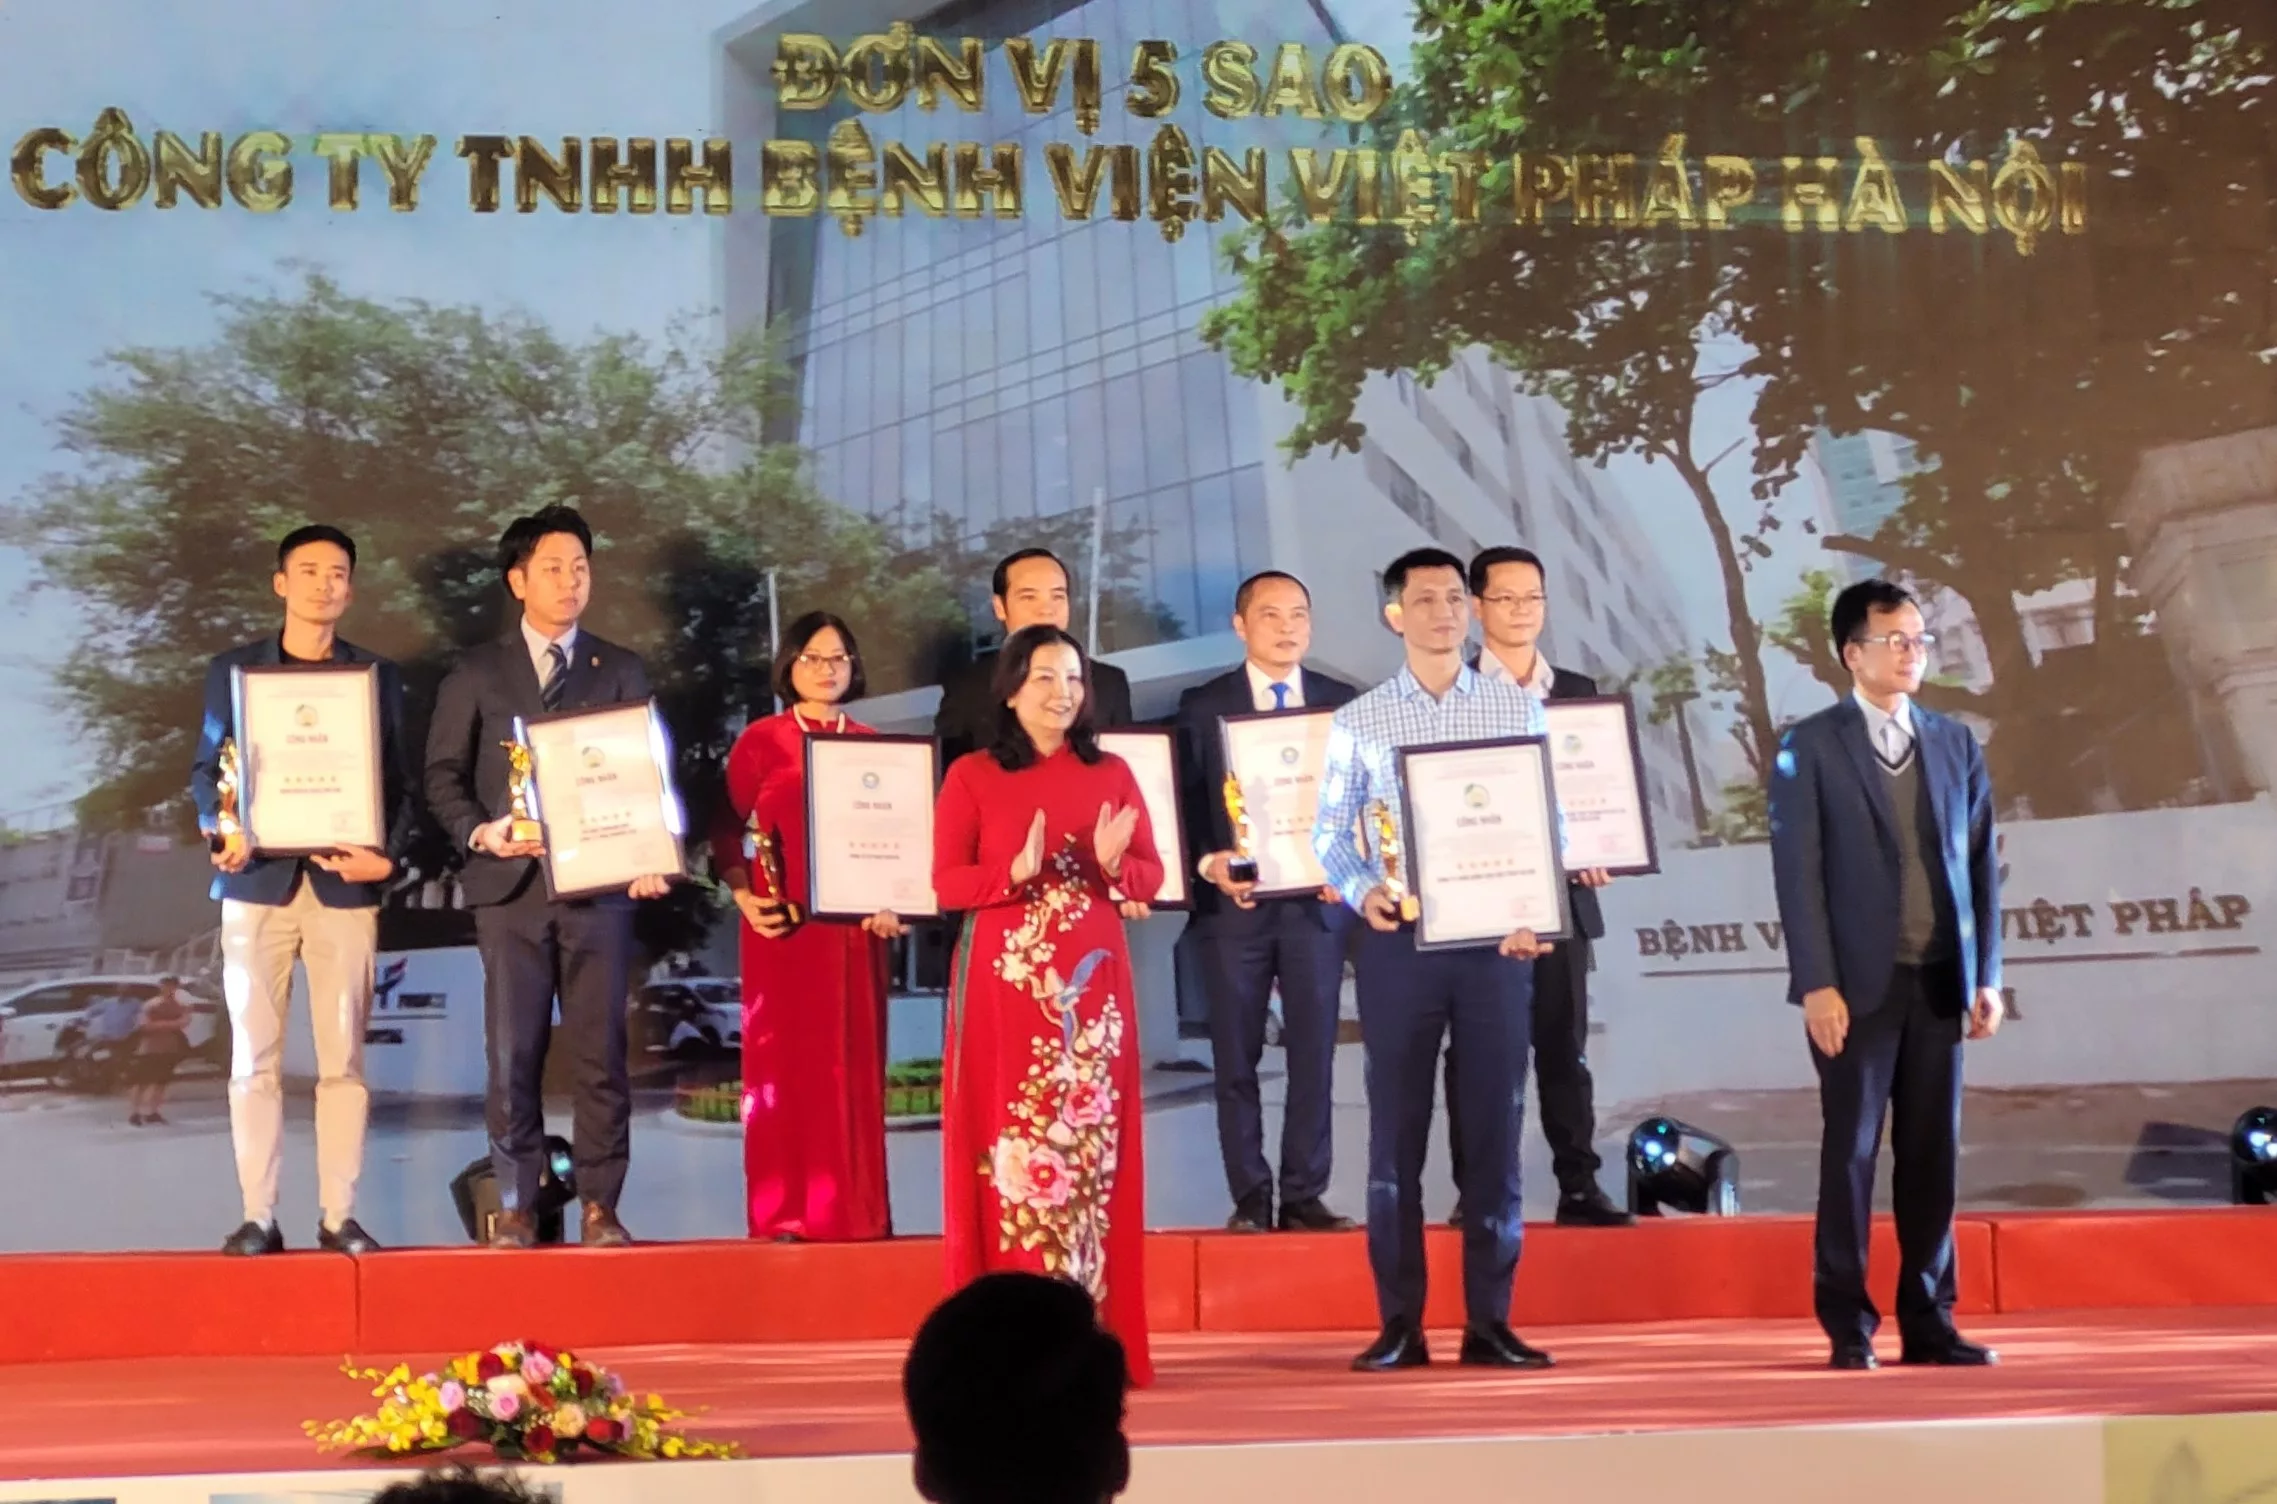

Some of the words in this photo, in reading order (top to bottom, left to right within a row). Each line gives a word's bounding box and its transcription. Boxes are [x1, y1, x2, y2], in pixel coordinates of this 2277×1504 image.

[770, 20, 985, 114] ĐƠN
[1003, 37, 1102, 136] VỊ
[1126, 40, 1180, 119] 5
[1202, 39, 1393, 122] SAO
[10, 106, 294, 213] CÔNG
[311, 132, 437, 212] TY
[455, 135, 733, 214] TNHH
[761, 117, 1023, 239] BỆNH
[1043, 122, 1267, 244] VIỆN
[1290, 128, 1494, 246] VIỆT
[1513, 133, 1757, 231] PHÁP
[1780, 135, 1907, 233] HÀ
[1928, 138, 2089, 257] NỘI
[1634, 918, 1748, 961] BỆNH
[2106, 886, 2252, 936] PHÁP
